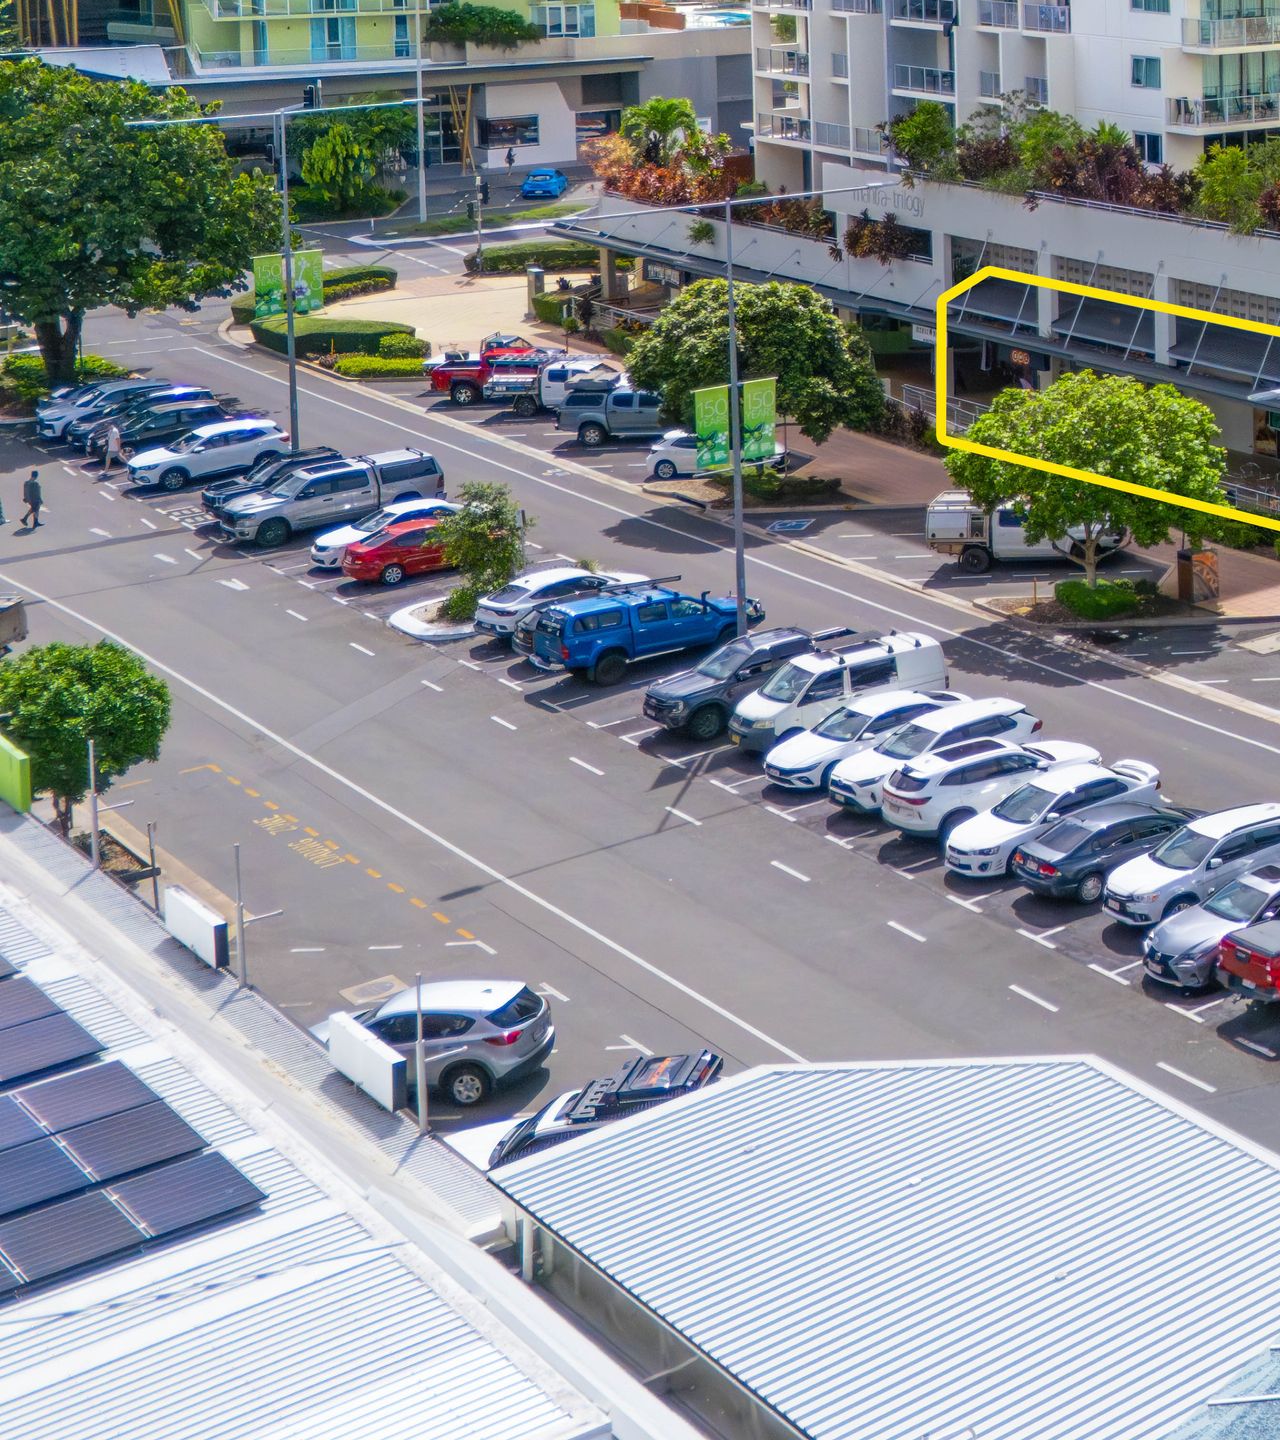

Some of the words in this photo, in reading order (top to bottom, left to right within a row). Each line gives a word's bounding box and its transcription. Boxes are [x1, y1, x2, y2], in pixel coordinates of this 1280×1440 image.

[893, 189, 925, 218] trilogy
[697, 397, 728, 419] 150
[748, 390, 774, 411] 150
